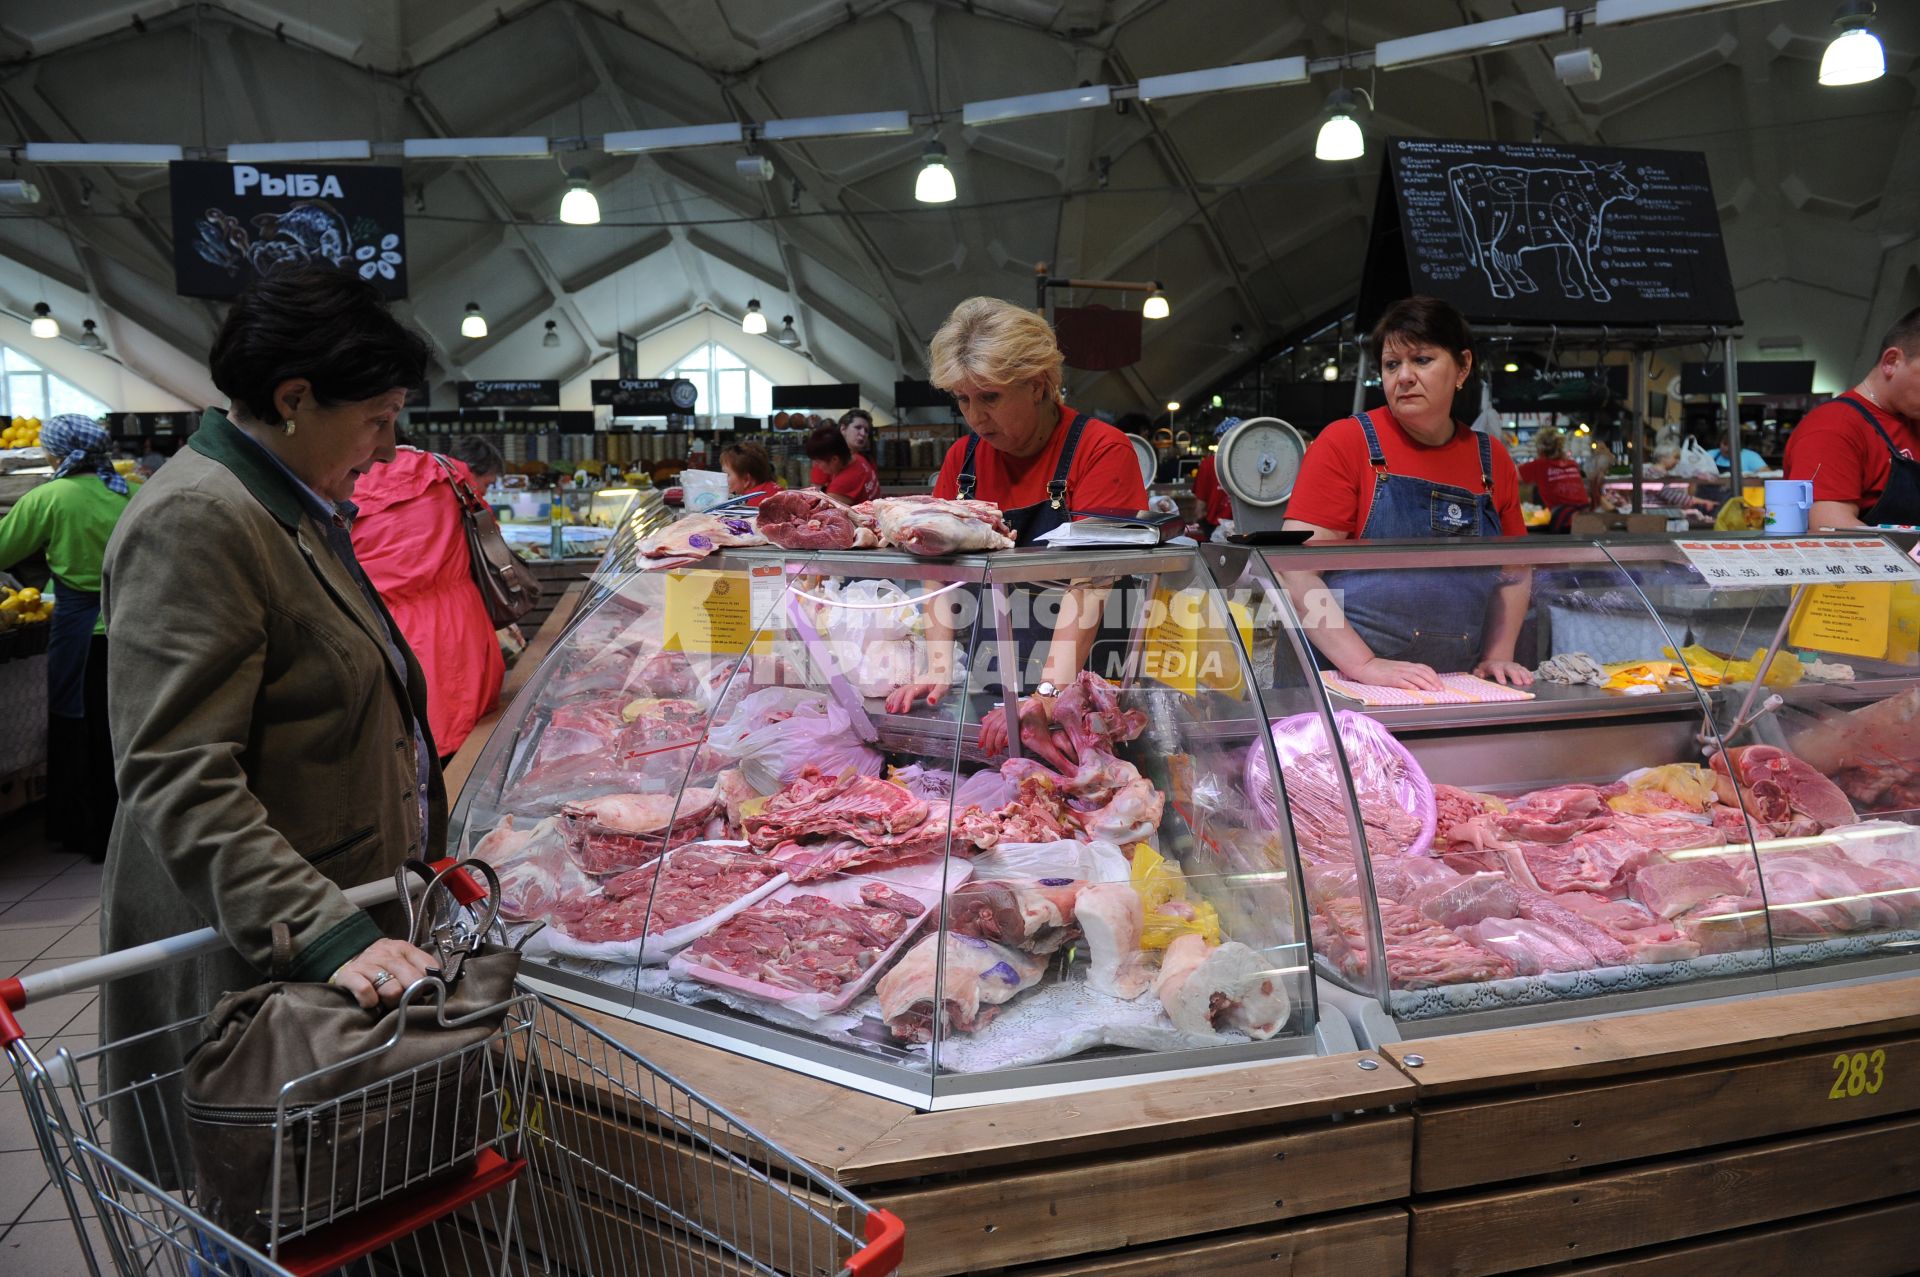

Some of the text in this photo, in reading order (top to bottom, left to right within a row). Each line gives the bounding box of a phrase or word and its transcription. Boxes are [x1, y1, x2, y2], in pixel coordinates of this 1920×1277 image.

[232, 165, 344, 198] РЫБА
[1828, 1049, 1886, 1099] 283
[497, 1088, 546, 1148] 24
